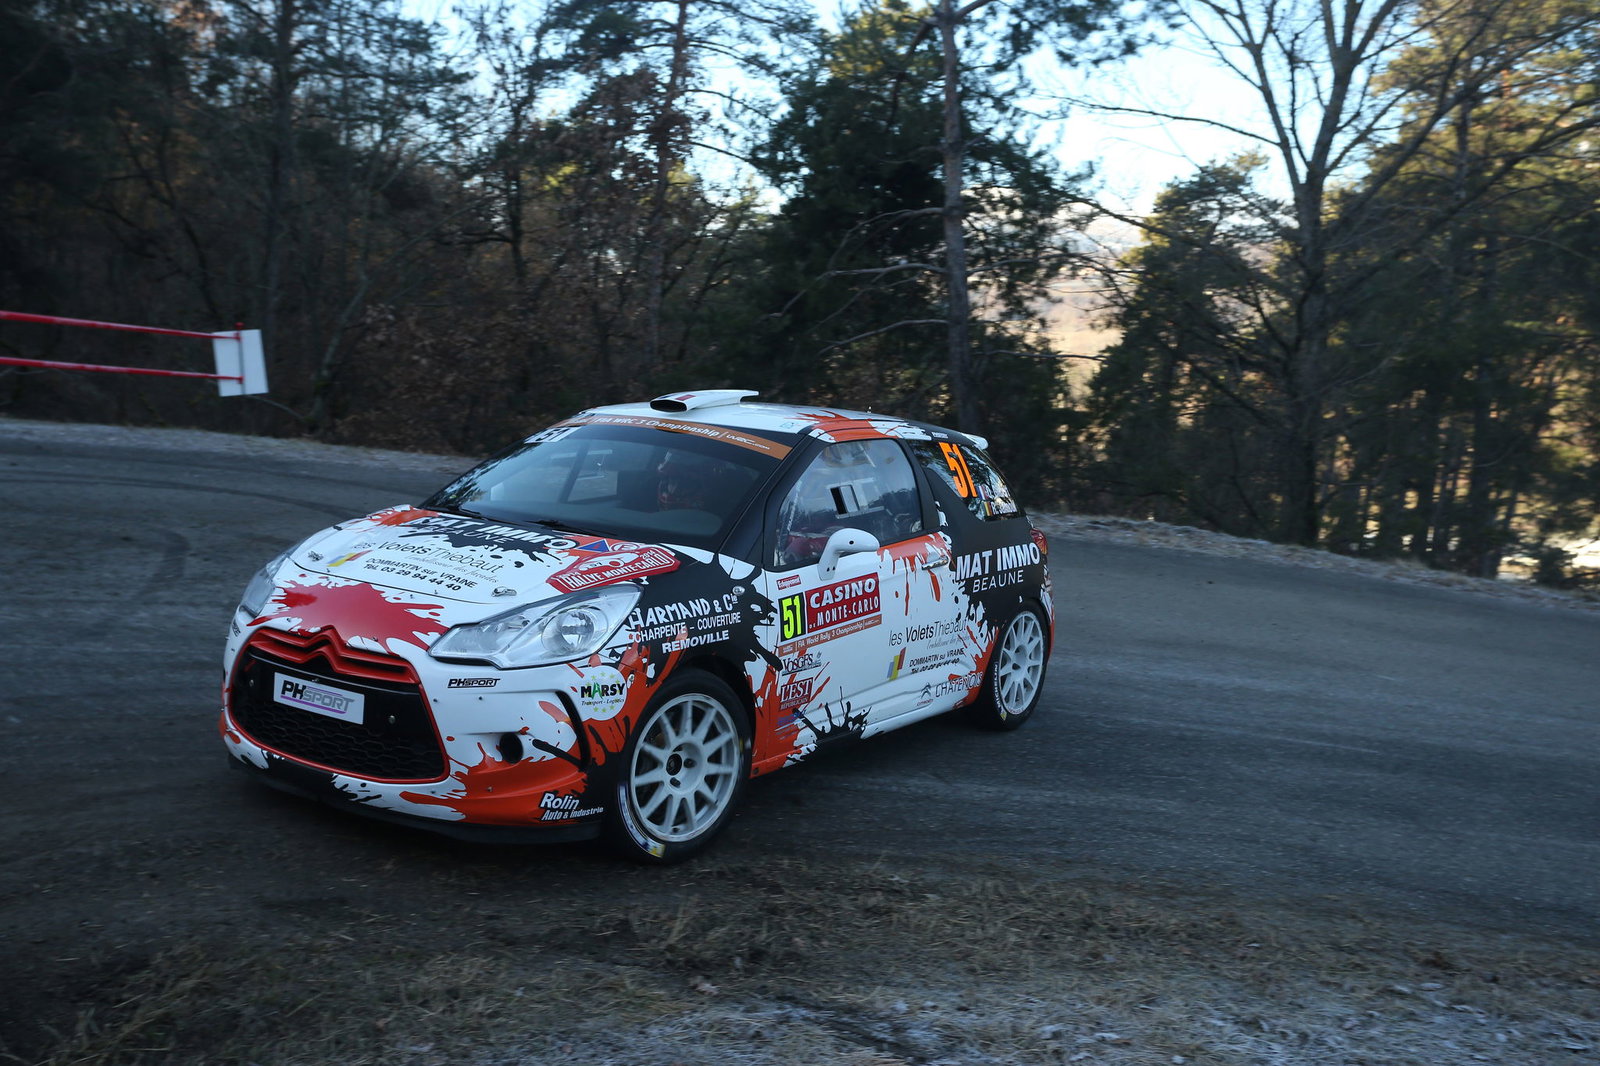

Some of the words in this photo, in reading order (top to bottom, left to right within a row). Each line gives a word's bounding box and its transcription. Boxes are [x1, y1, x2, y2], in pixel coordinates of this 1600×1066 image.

[646, 420, 720, 438] Championship
[939, 442, 978, 497] 51
[475, 525, 576, 549] IMMO
[366, 558, 422, 571] DOMMARTIN
[440, 572, 478, 588] VRAINE
[561, 573, 605, 589] RALLYE
[602, 554, 671, 578] MONTE-CARLO
[955, 549, 992, 583] MAT
[997, 542, 1041, 572] IMMO
[445, 583, 461, 591] 40
[810, 578, 876, 608] CASINO
[972, 569, 1024, 593] BEAUNE
[628, 597, 711, 630] HARMAND
[713, 600, 722, 613] &
[782, 595, 802, 639] 51
[817, 596, 879, 626] MONTE-CARLO
[634, 621, 687, 643] CHARPENTE
[697, 612, 742, 631] COUVERTURE
[889, 630, 903, 647] les
[661, 630, 730, 654] REMOVILLE
[580, 682, 626, 700] MARSY
[781, 680, 811, 702] L'EST
[540, 792, 580, 809] Rolin
[541, 808, 562, 821] Auto
[563, 811, 568, 819] &
